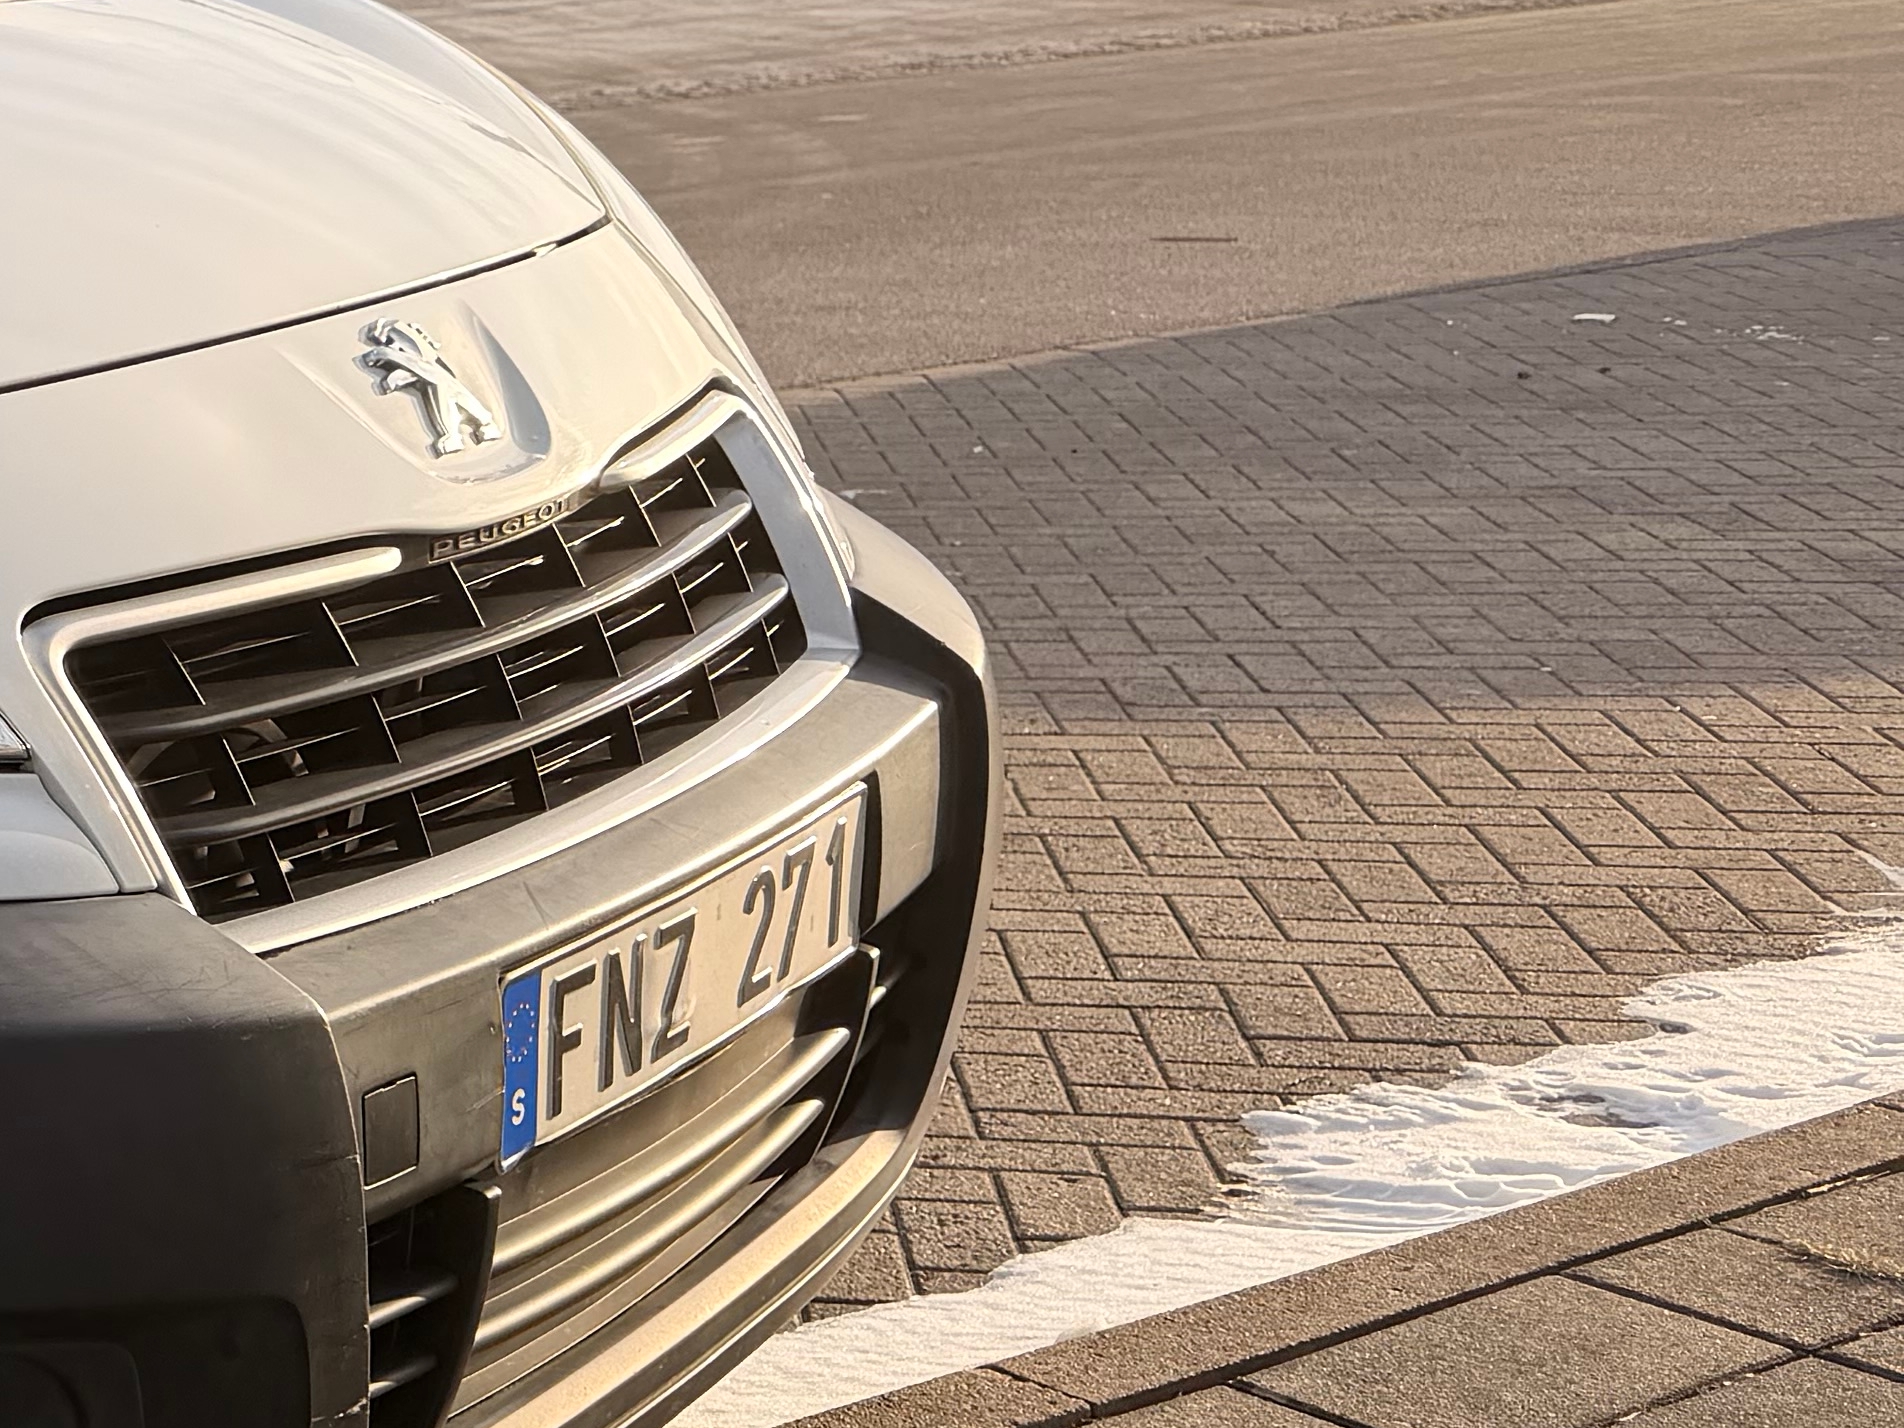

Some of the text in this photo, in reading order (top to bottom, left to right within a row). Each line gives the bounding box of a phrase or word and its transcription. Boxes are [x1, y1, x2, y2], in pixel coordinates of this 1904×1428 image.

[432, 498, 568, 559] PEUGEOT
[545, 815, 848, 1122] FNZ 271
[510, 1088, 526, 1126] S
